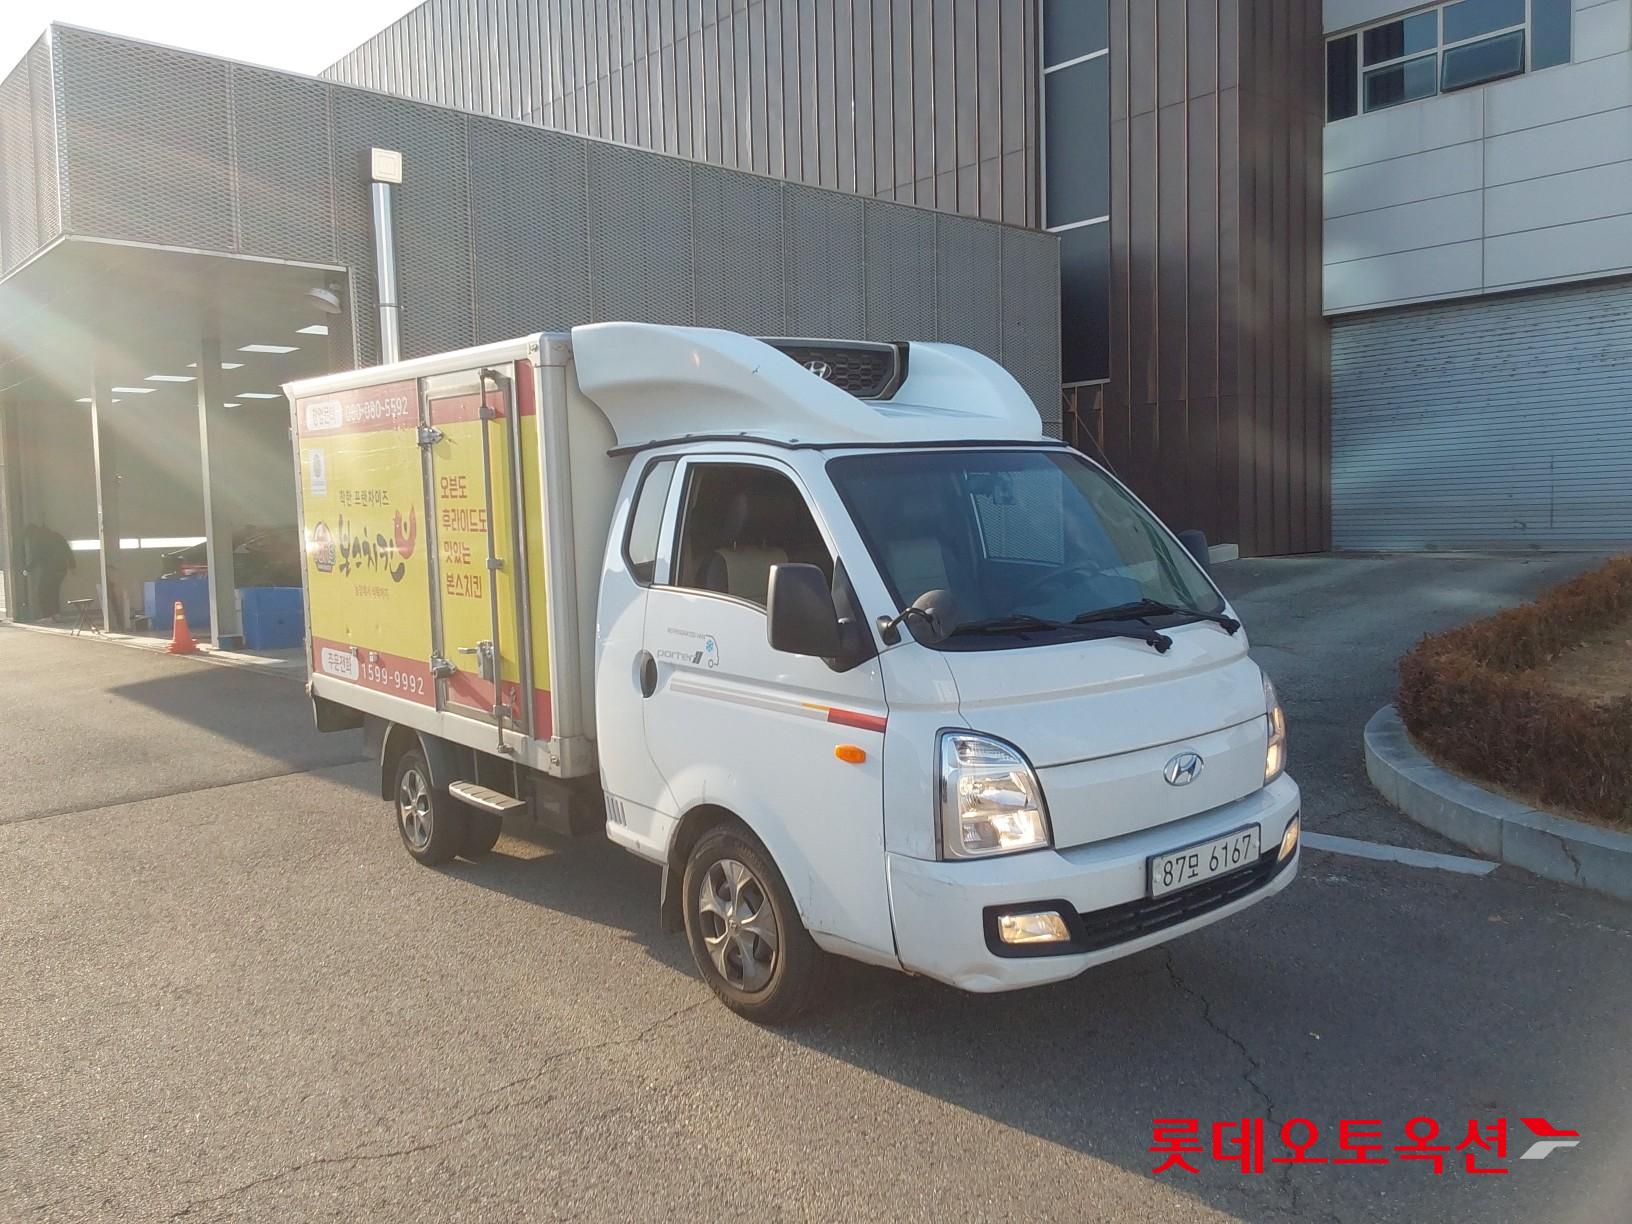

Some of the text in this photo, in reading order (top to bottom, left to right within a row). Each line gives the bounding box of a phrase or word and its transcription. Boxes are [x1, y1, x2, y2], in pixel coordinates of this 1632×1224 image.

[440, 476, 467, 499] 오븐도
[442, 508, 487, 533] 후라이드도
[444, 541, 471, 565] 맛있는
[446, 573, 483, 599] 본스치킨
[361, 663, 425, 695] 1599-9992
[1163, 834, 1251, 887] 87모 6167
